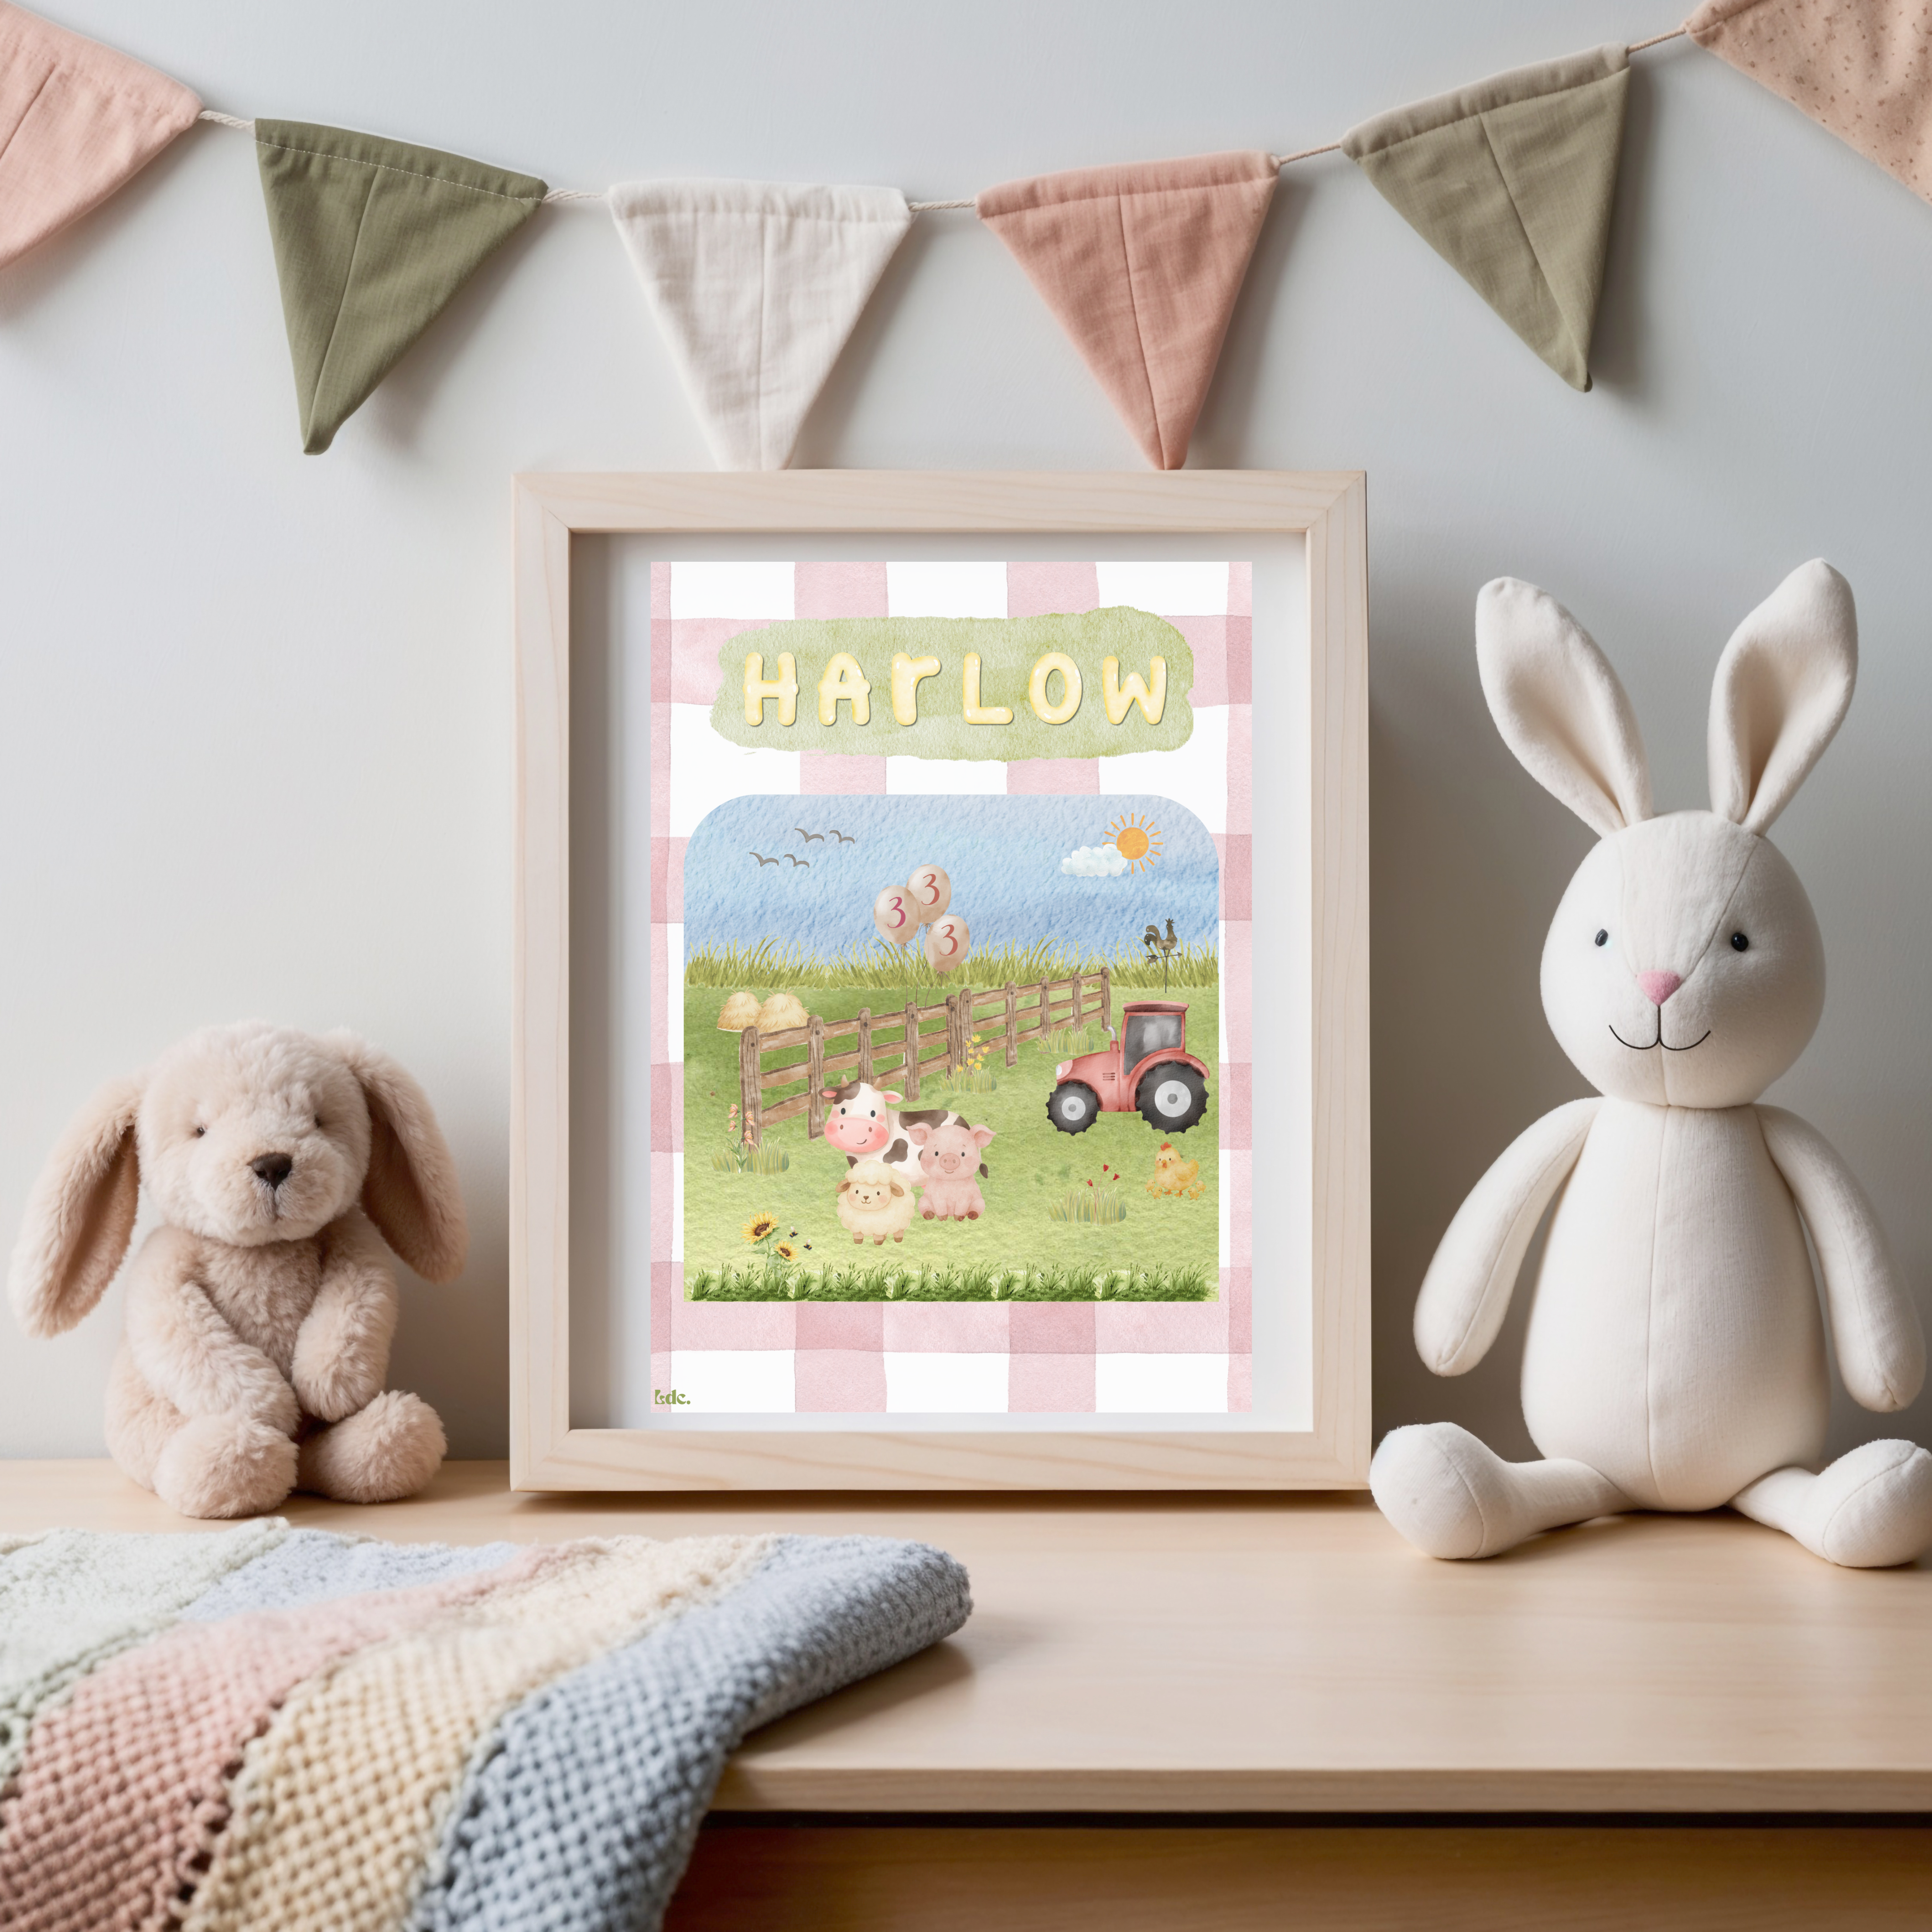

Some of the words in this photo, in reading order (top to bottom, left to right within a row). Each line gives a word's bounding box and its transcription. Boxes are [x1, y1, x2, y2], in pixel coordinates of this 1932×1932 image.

[921, 874, 940, 906] 3
[887, 897, 906, 928] 3
[940, 924, 958, 956] 3
